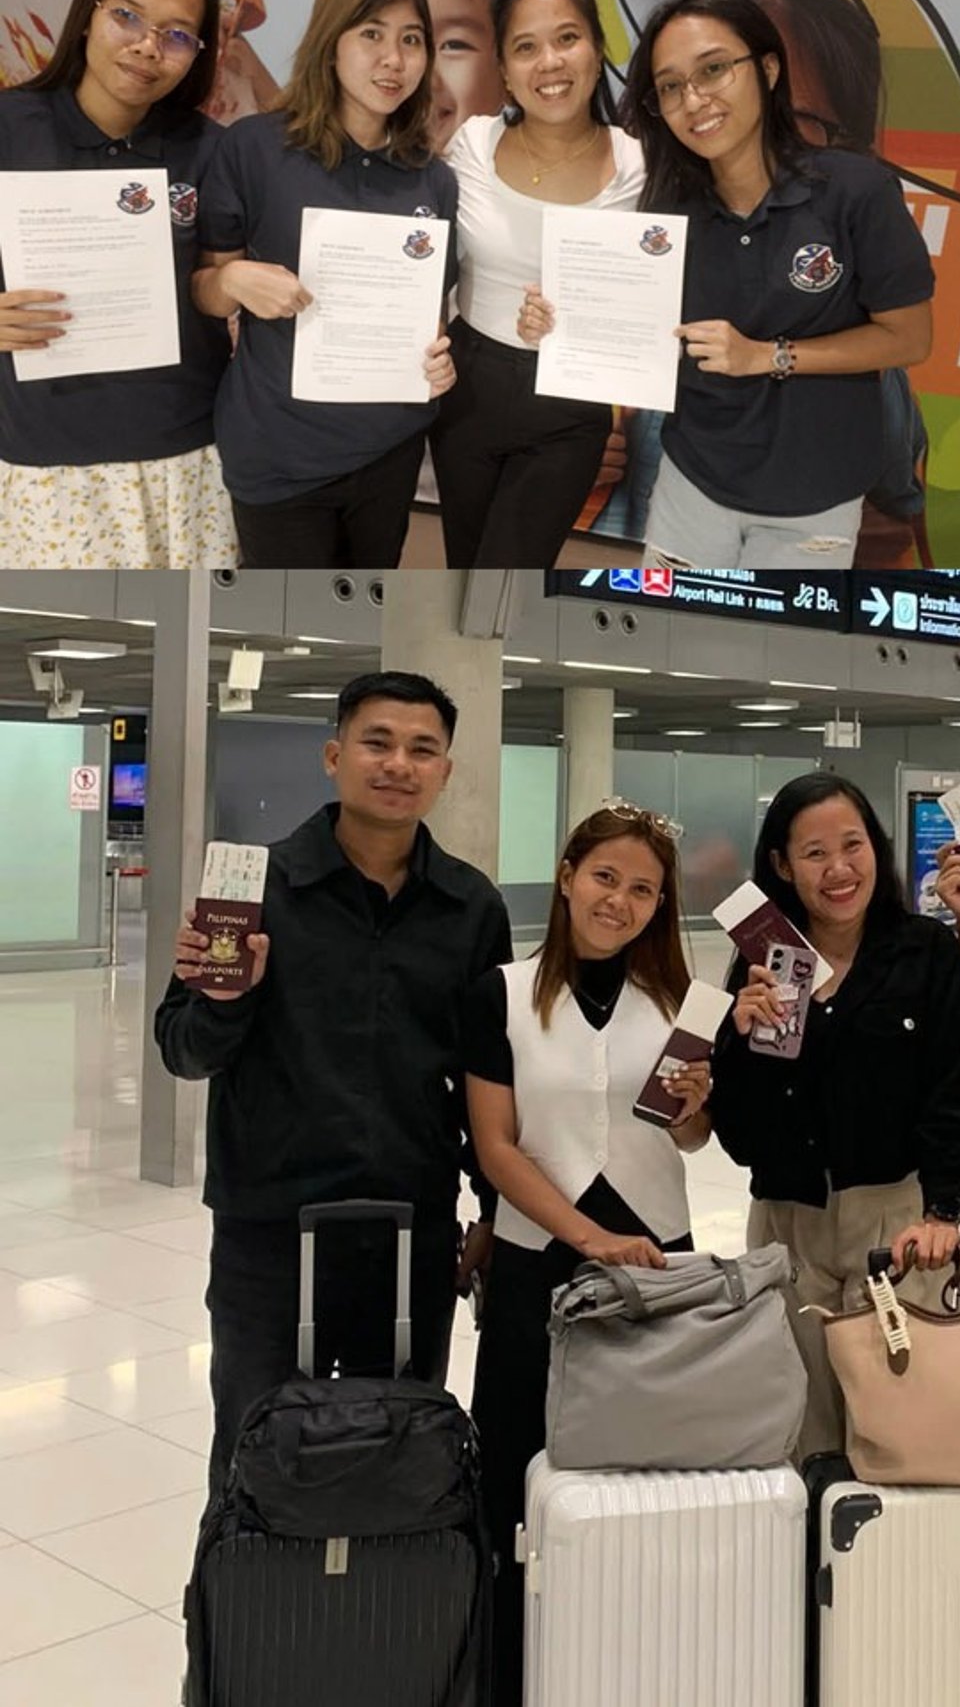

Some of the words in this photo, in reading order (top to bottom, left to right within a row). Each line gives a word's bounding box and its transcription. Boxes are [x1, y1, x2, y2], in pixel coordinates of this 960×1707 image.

[674, 585, 705, 602] Airport
[706, 589, 725, 604] Rail
[726, 592, 746, 607] Link
[206, 913, 248, 926] PILIPINAS
